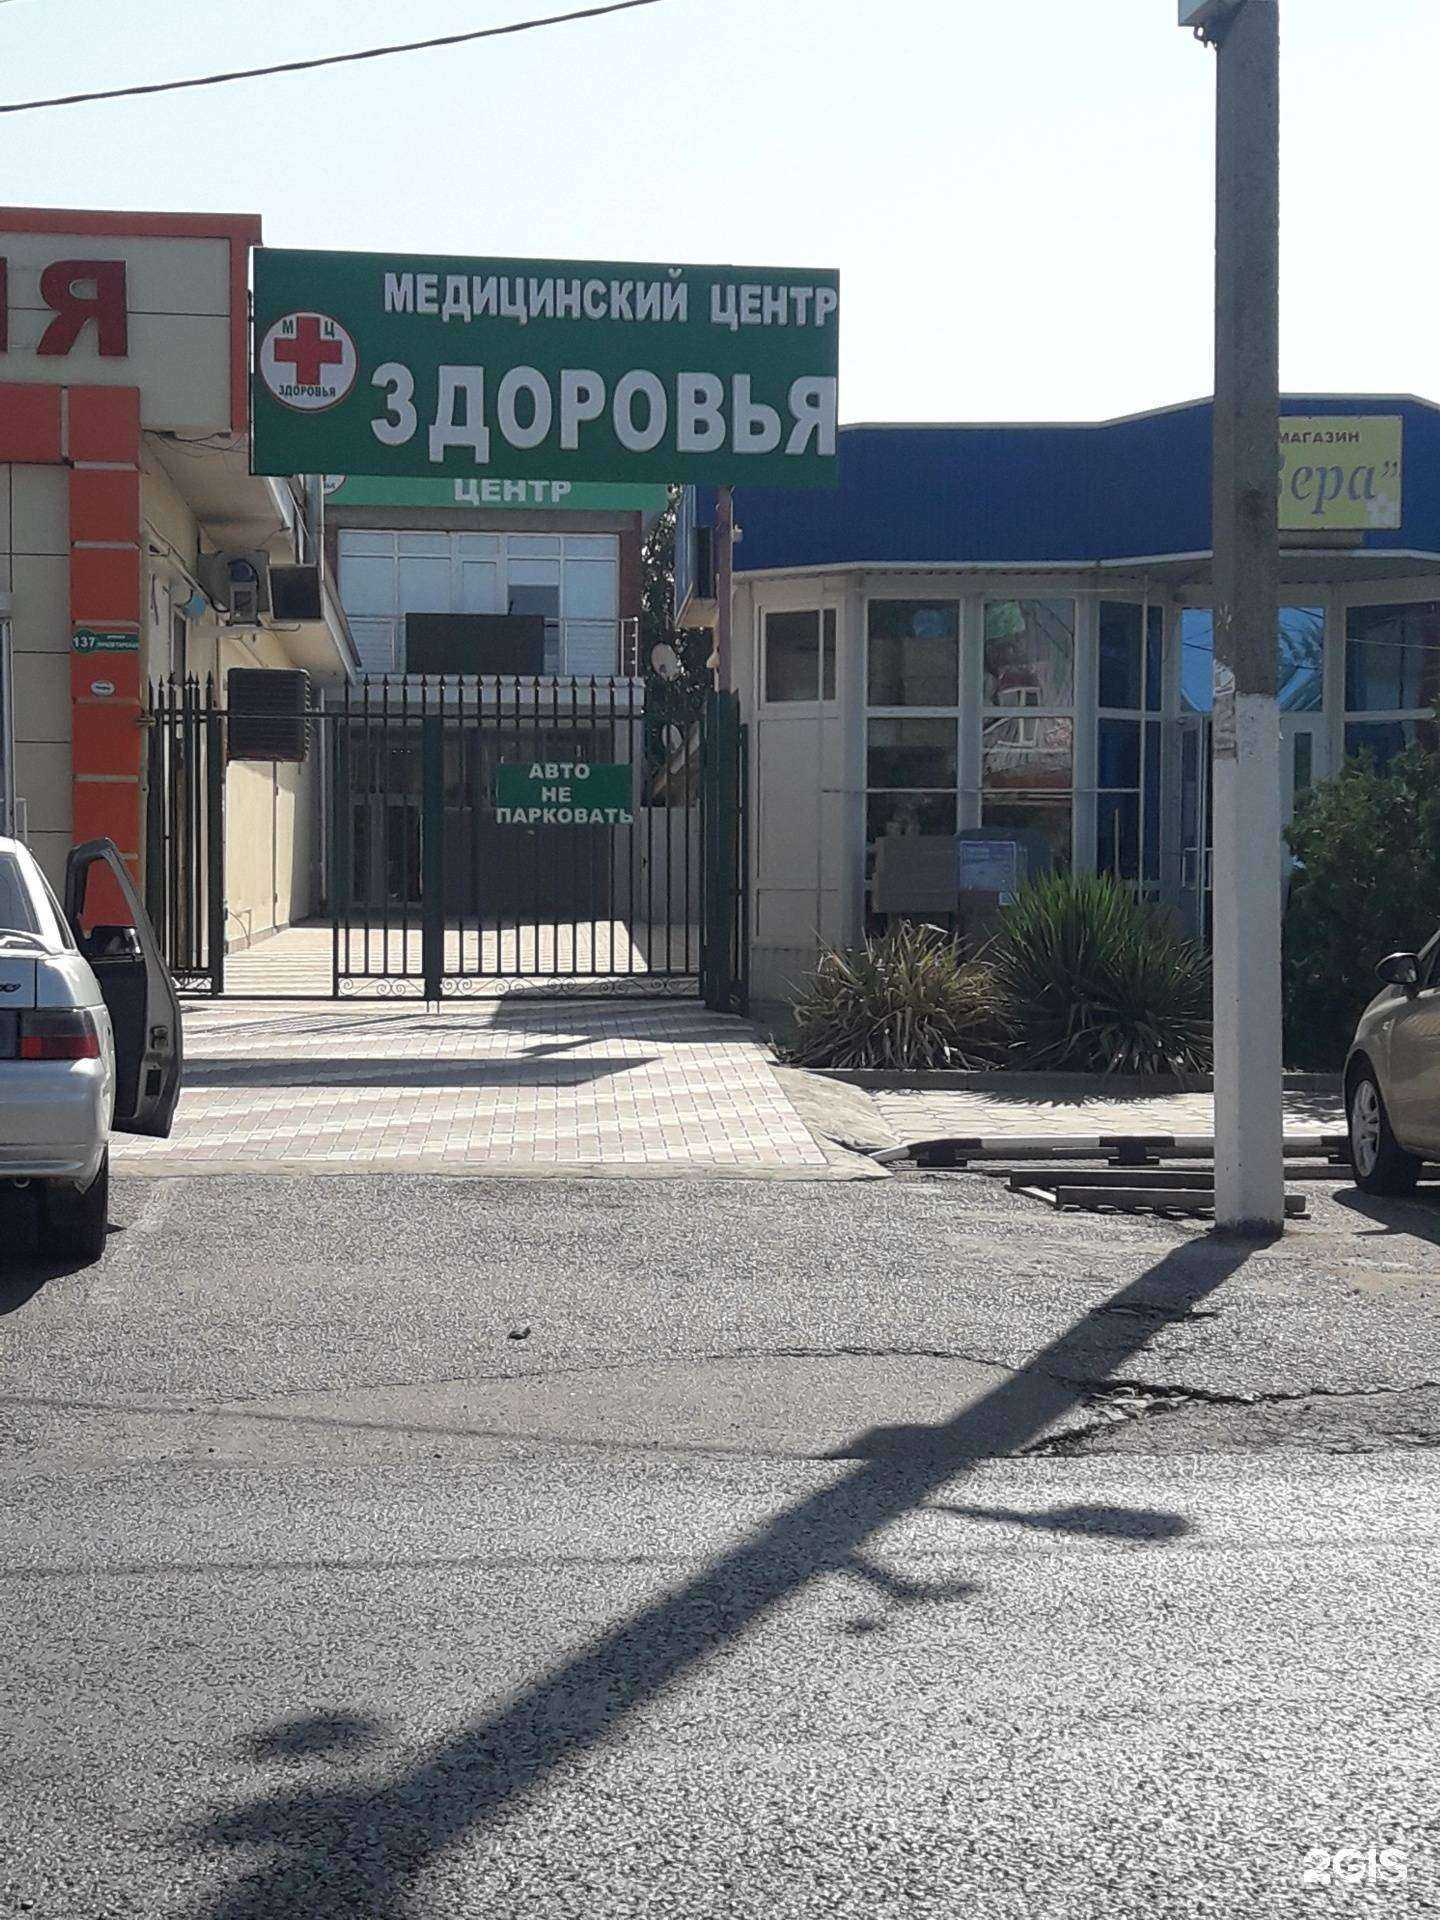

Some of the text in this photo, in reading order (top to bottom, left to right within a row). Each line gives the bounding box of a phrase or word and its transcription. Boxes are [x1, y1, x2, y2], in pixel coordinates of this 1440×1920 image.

[383, 268, 838, 331] МЕДИЦИНСКИЙ ЦЕНТР
[279, 385, 336, 397] ЗДОРОВЬЯ
[370, 362, 837, 464] ЗДОРОВЬЯ
[454, 478, 571, 506] ЦЕНТР
[73, 636, 96, 648] 137
[528, 763, 591, 779] АВТО
[541, 787, 572, 802] НЕ
[495, 807, 634, 825] ПАРКОВАТЬ
